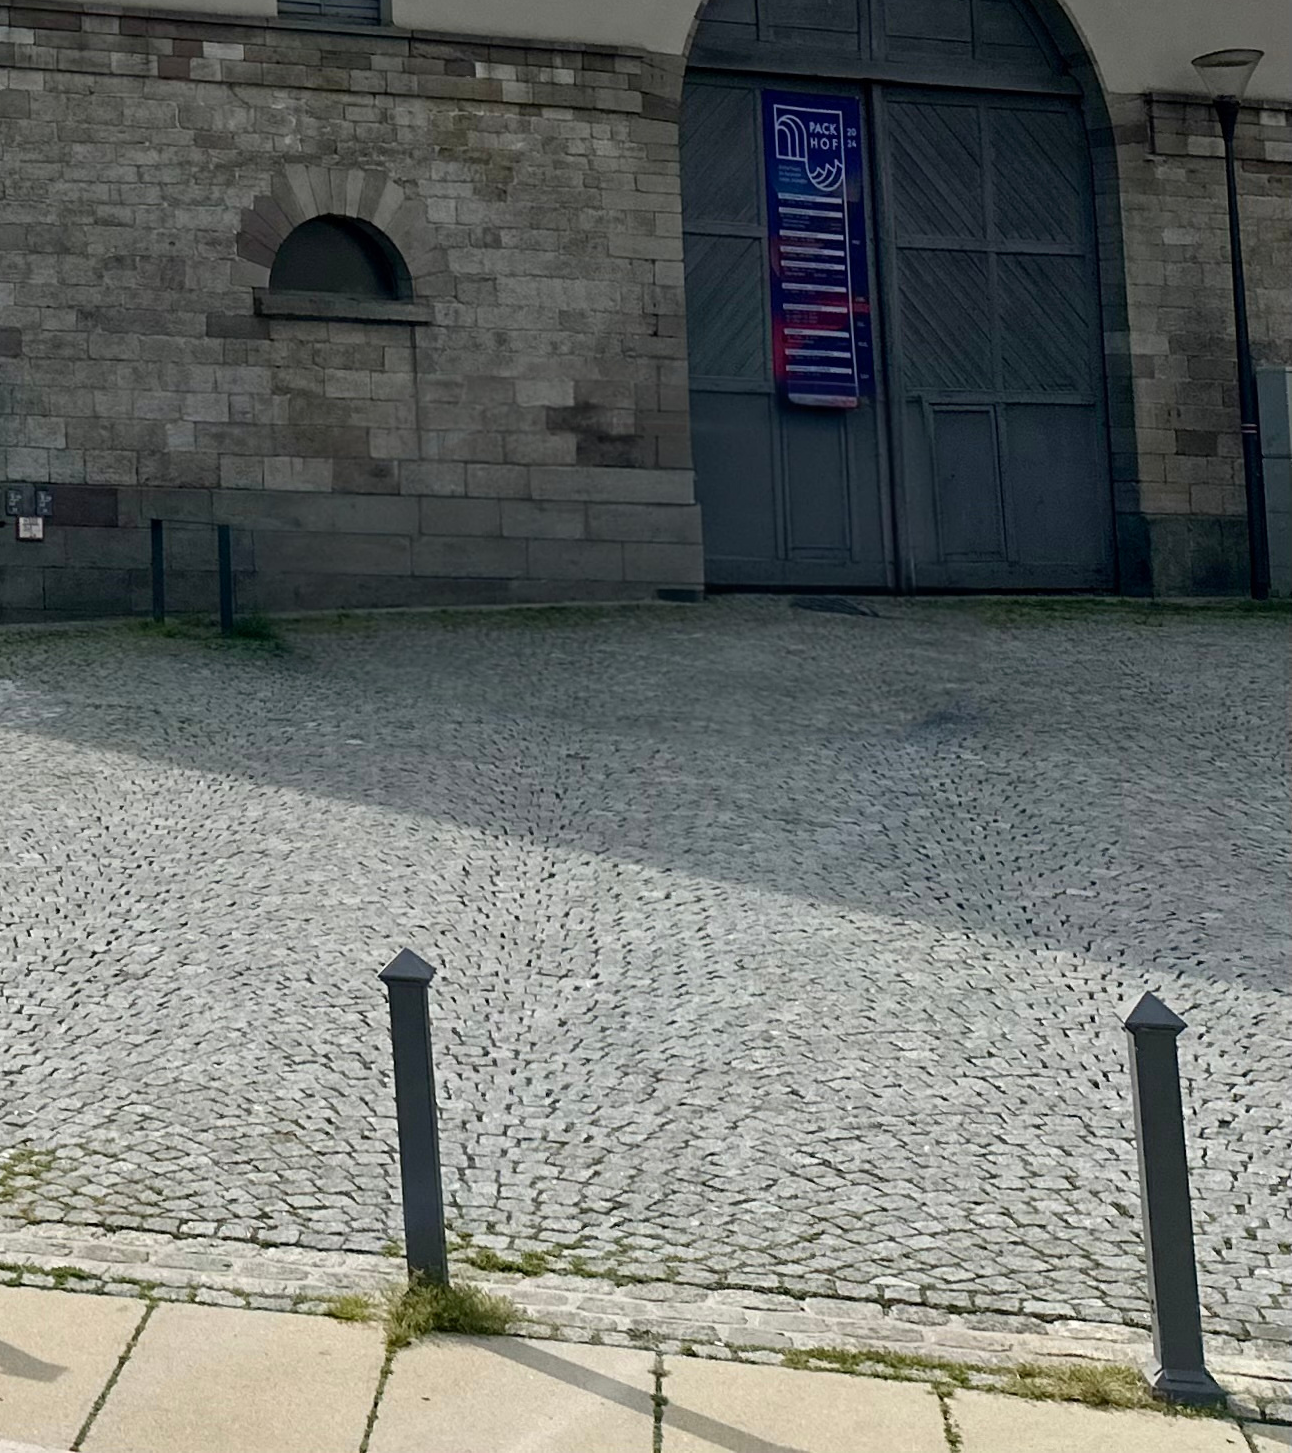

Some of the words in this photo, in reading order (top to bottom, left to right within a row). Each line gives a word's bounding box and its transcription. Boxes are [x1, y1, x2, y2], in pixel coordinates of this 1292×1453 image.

[809, 121, 838, 136] PACK
[846, 127, 857, 137] 20
[810, 137, 839, 151] HOF
